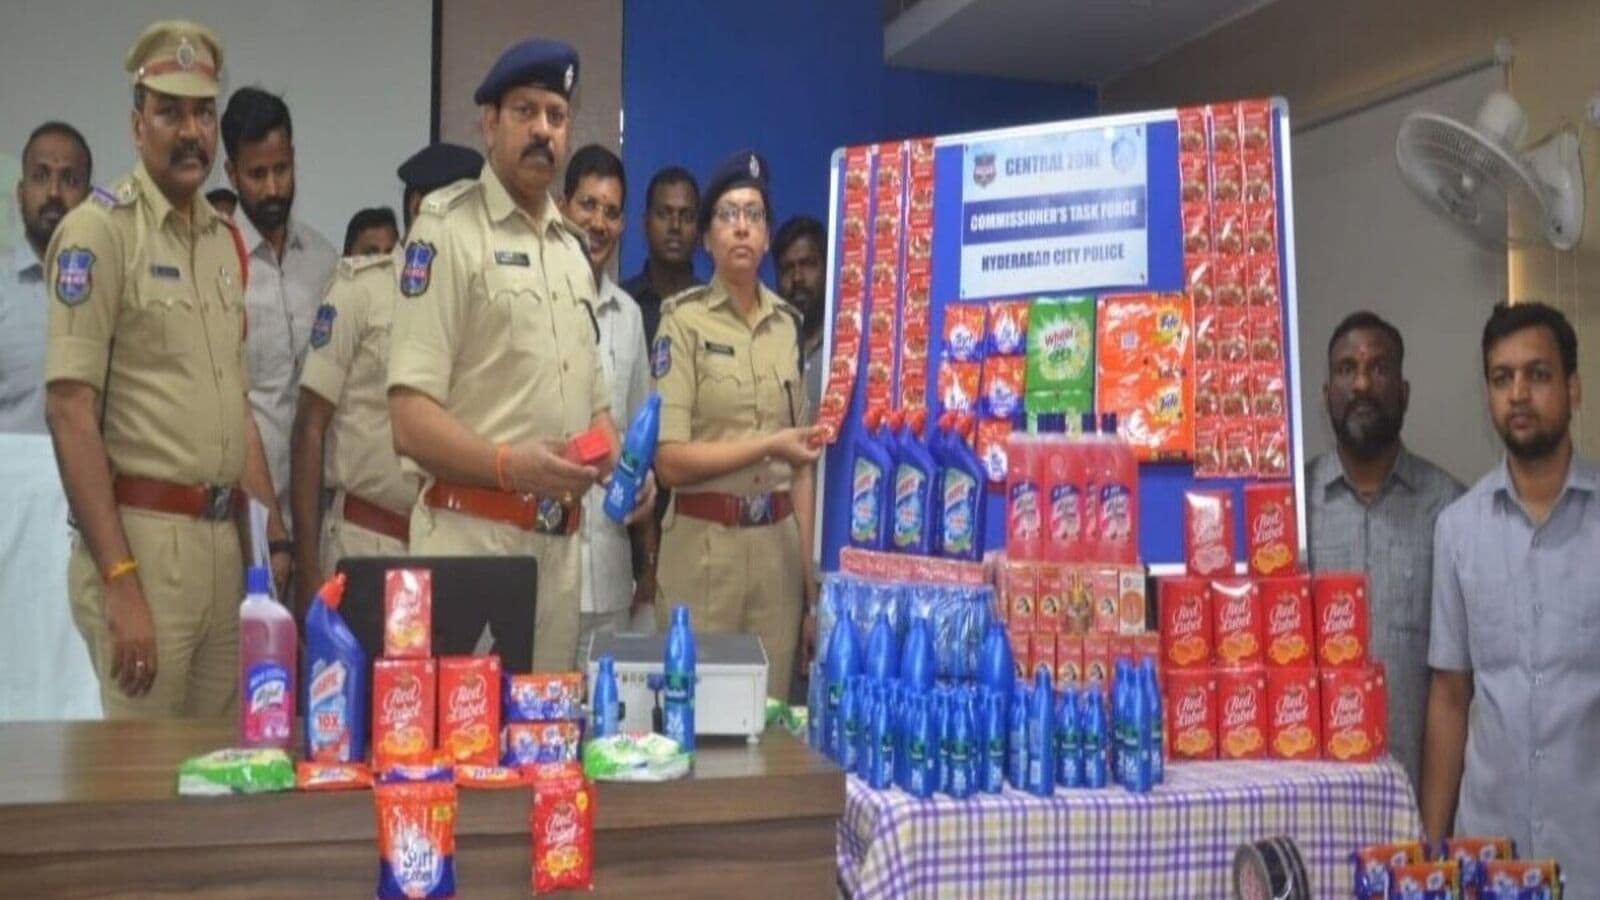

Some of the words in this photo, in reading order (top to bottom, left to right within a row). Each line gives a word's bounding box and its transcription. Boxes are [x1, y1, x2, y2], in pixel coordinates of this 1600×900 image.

[1005, 152, 1064, 177] CENTRAL
[970, 204, 1067, 232] COMMISSIONER'S
[1070, 201, 1099, 223] TASK
[1100, 199, 1138, 219] FORCE
[981, 250, 1050, 272] HYDERABAD
[1053, 247, 1081, 266] CITY
[1083, 243, 1125, 264] POLICE
[391, 684, 417, 704] Red
[455, 682, 483, 704] Red
[386, 701, 422, 723] Label
[450, 699, 487, 721] Label
